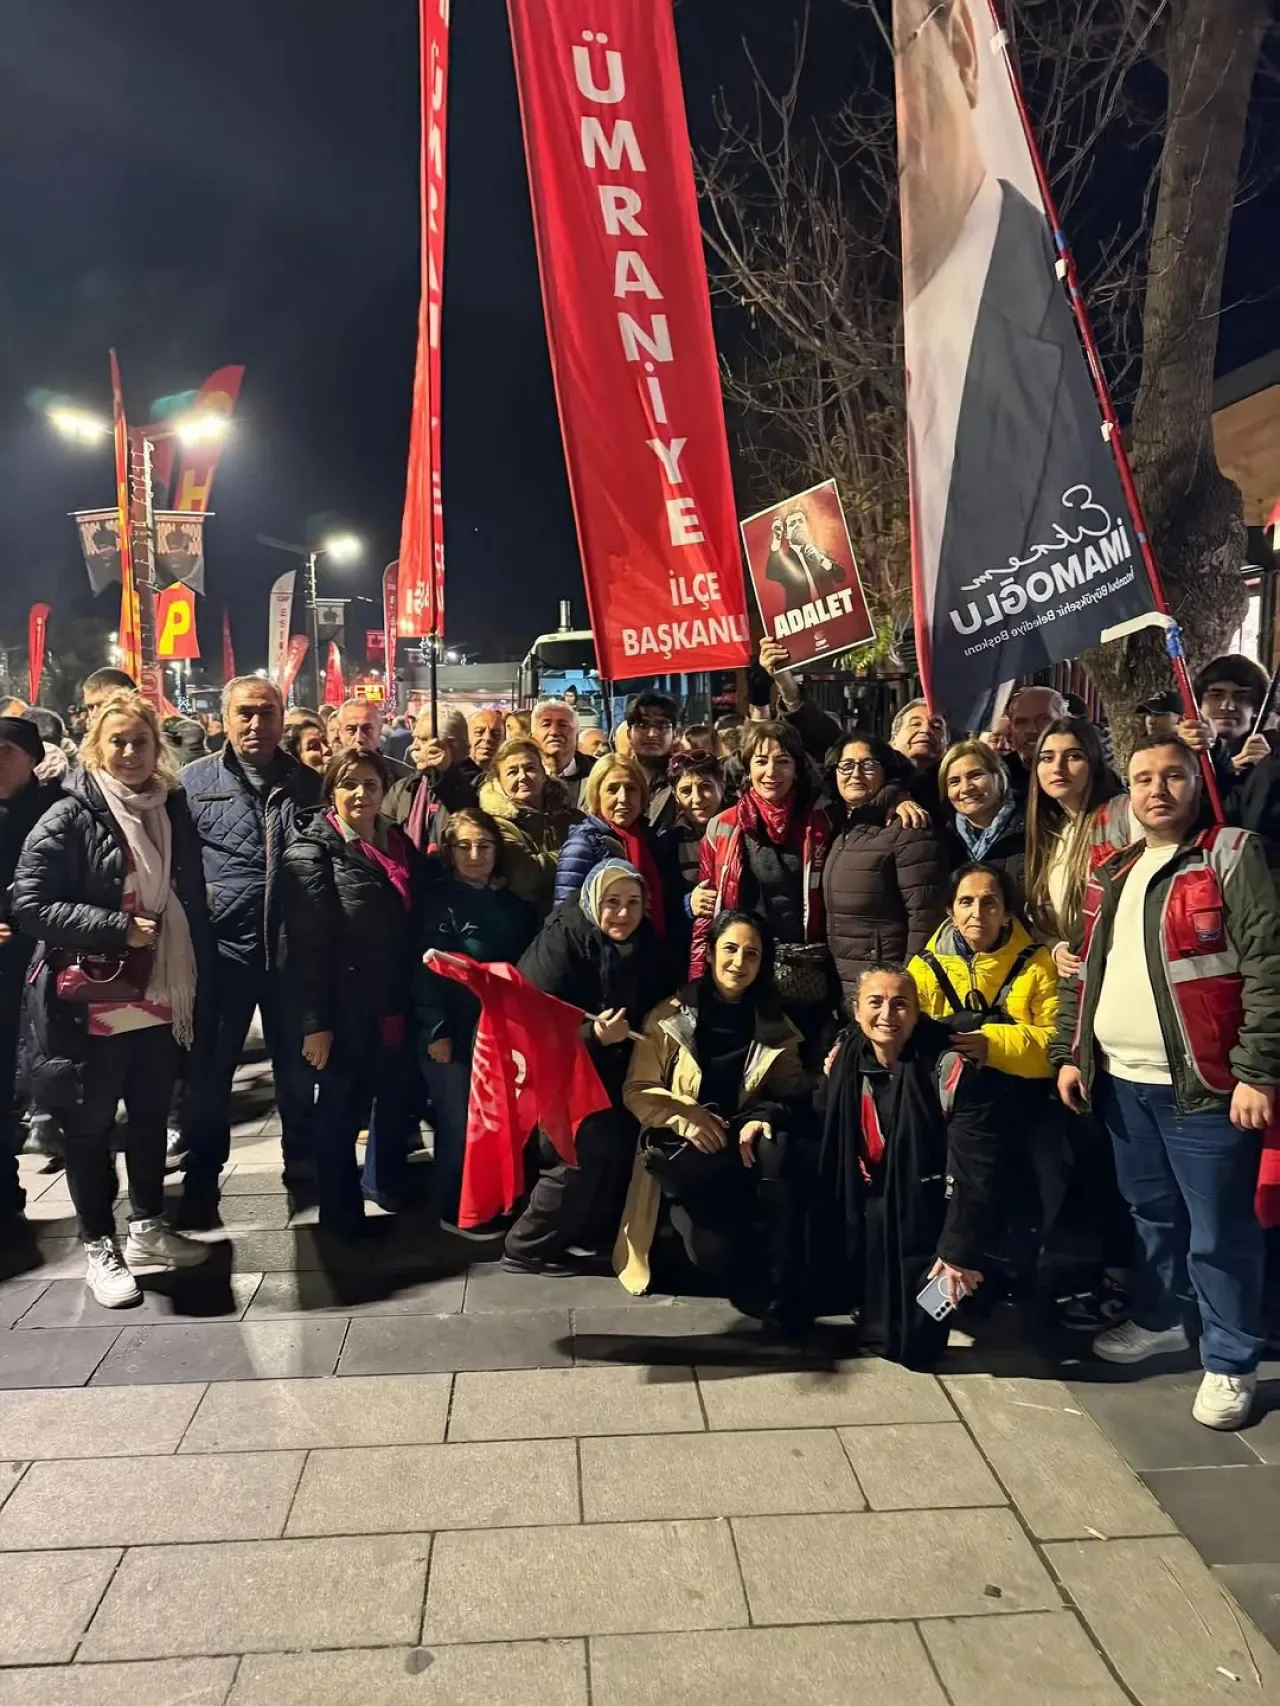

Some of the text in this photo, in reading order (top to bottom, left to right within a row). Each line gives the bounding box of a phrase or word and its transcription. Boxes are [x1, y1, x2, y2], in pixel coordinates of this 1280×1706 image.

[572, 30, 705, 547] ÜMRANİYE
[669, 569, 721, 610] İLÇE
[774, 588, 853, 640] ADALET
